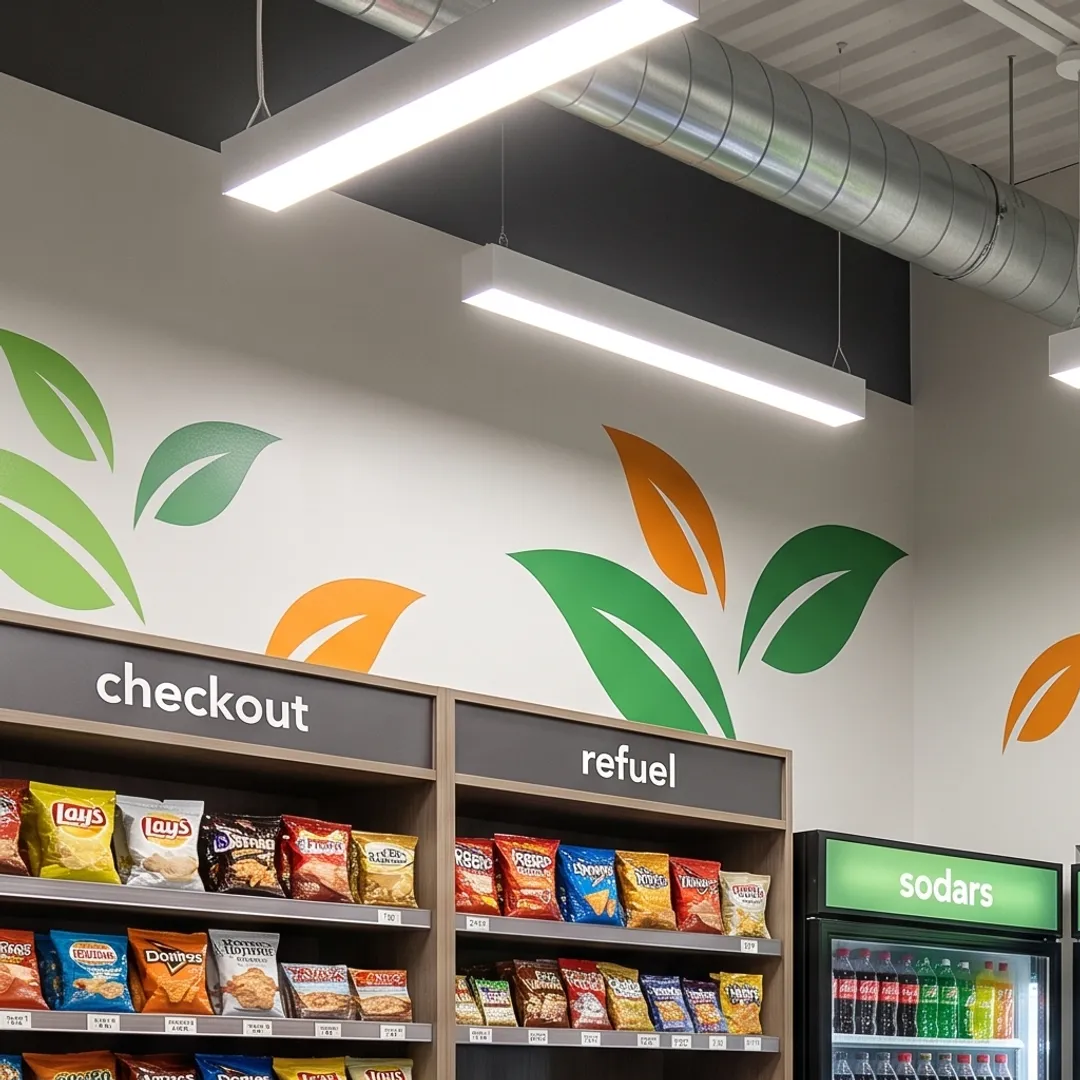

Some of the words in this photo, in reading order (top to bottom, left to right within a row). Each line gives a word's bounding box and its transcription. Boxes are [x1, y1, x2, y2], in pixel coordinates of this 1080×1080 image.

[96, 661, 309, 732] checkout
[582, 744, 676, 788] refuel
[899, 868, 994, 907] sodars
